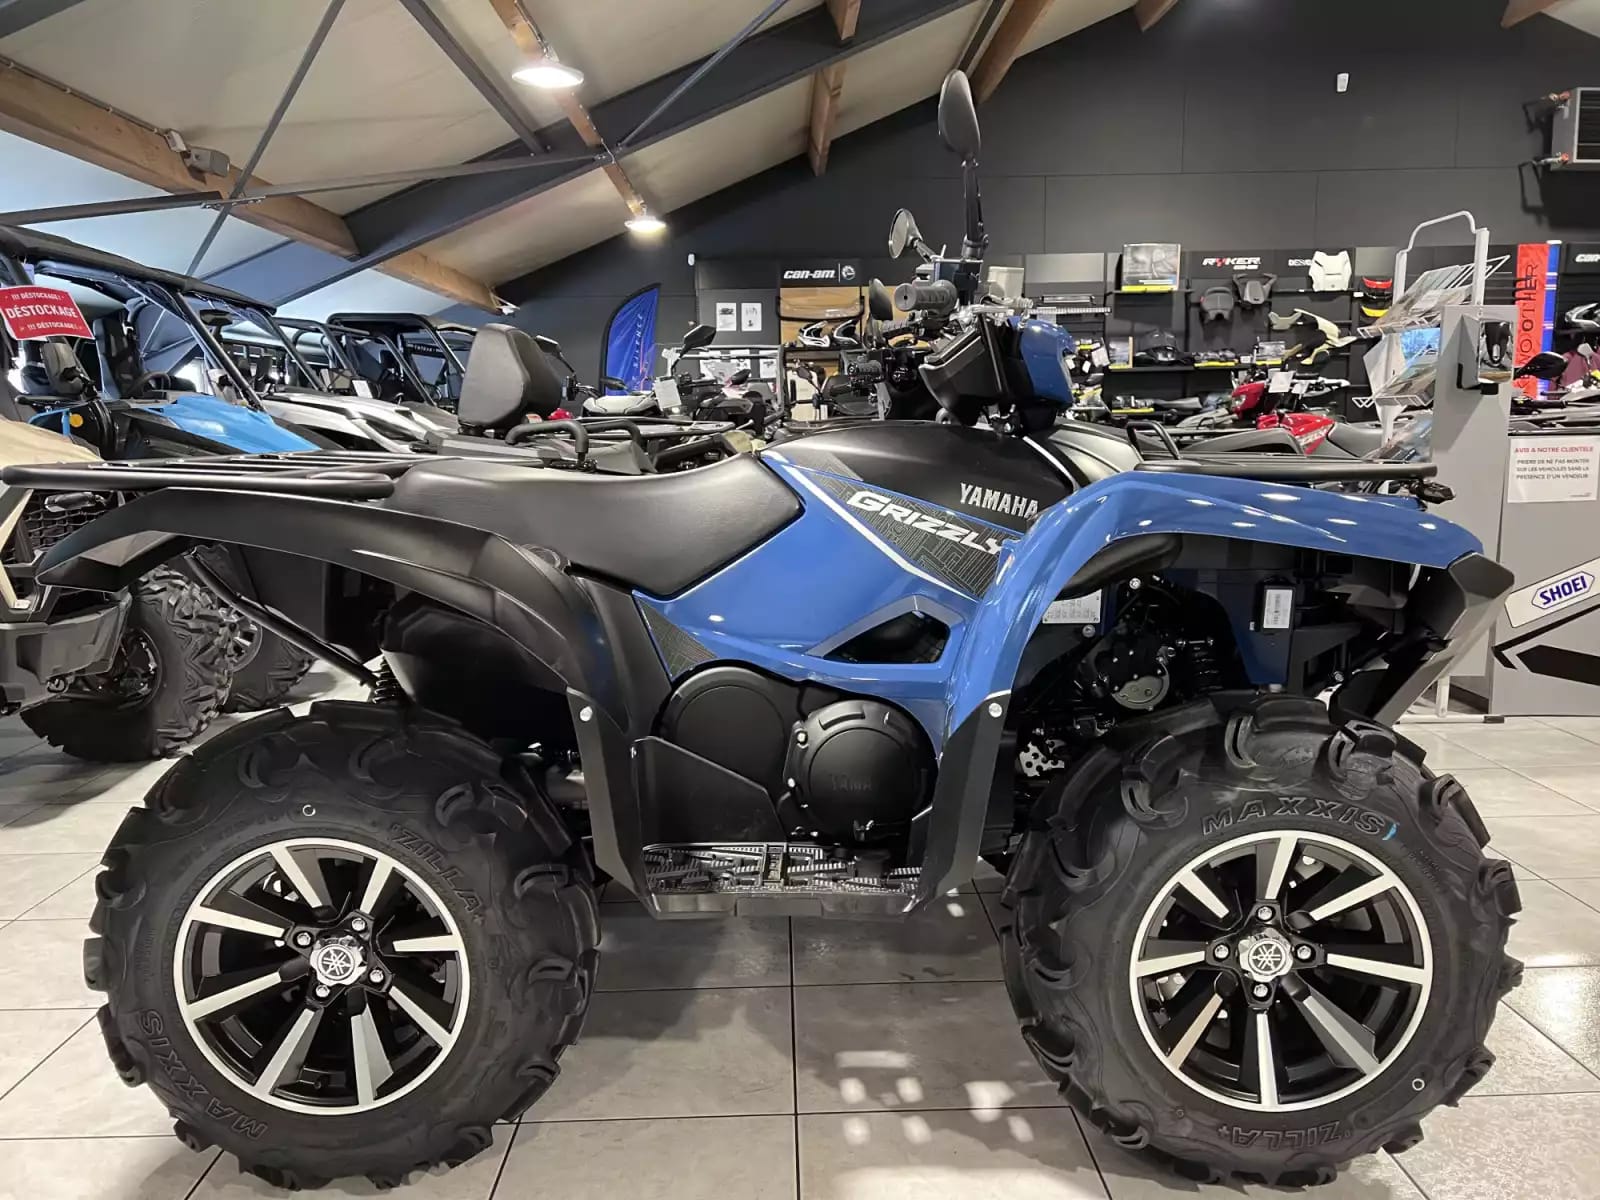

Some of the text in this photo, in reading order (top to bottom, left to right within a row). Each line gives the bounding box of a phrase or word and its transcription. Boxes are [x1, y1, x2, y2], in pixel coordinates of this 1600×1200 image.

[5, 304, 78, 318] DÉSTOCKAGE
[960, 483, 1039, 519] YAMAHA
[847, 490, 1003, 555] GRIZZLY
[1540, 575, 1588, 605] SHOEI
[1201, 797, 1386, 836] MAXXIS
[140, 1009, 268, 1140] MAXXIS
